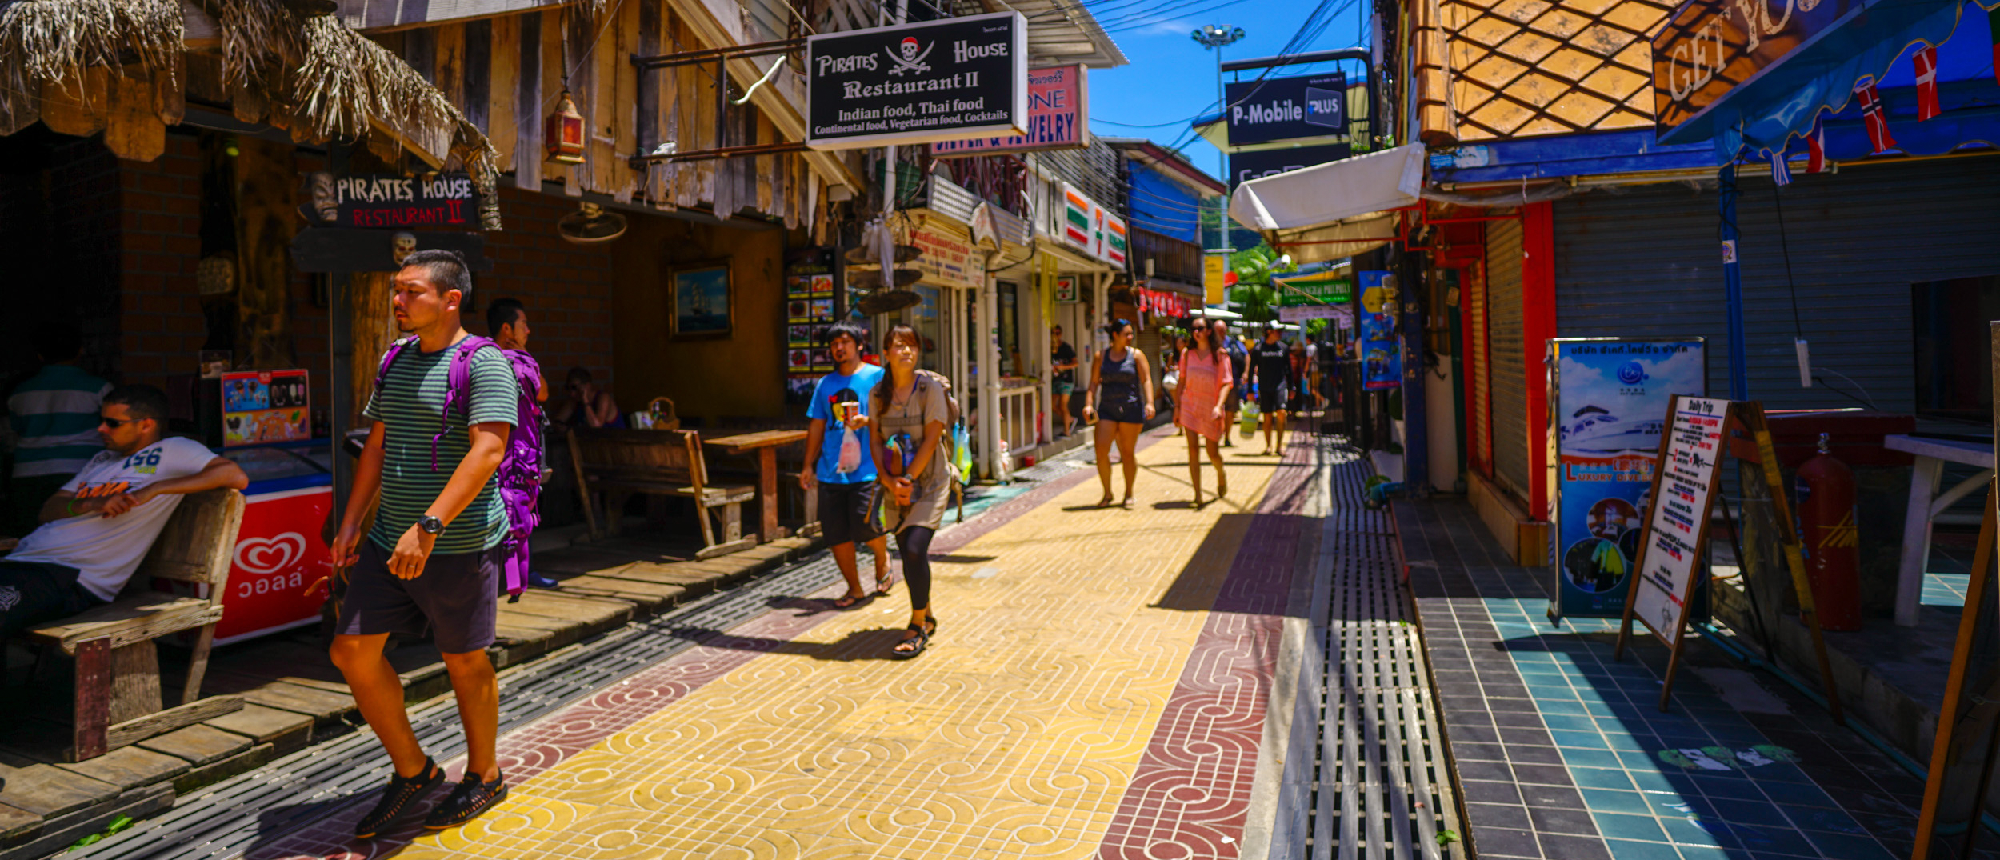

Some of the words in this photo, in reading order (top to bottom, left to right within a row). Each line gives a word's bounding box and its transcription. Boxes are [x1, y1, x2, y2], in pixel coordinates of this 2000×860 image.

[814, 52, 879, 77] PIRATES
[953, 40, 1008, 63] HOUSE
[1670, 6, 1731, 101] GET
[1735, 0, 1820, 54] YO
[842, 73, 962, 99] Restaurant
[964, 71, 979, 88] II
[814, 121, 865, 135] Continental
[866, 119, 889, 131] food,
[889, 116, 939, 130] Vegetarian
[940, 113, 963, 125] food,
[964, 109, 1009, 122] Cocktails
[838, 107, 880, 122] Indian
[882, 102, 916, 118] food,
[918, 100, 950, 115] Thai
[953, 96, 984, 112] food
[1233, 99, 1303, 127] P-Mobile
[1309, 98, 1339, 115] PLUS
[336, 174, 415, 205] PIRATES
[421, 174, 473, 200] HOUSE
[352, 205, 446, 227] RESTAURANT
[446, 199, 467, 224] II
[1688, 399, 1702, 415] Daily
[1702, 400, 1714, 416] Trip
[1566, 460, 1613, 482] LUXURY
[1617, 473, 1639, 482] DIVE
[237, 566, 303, 599] วอลล์
